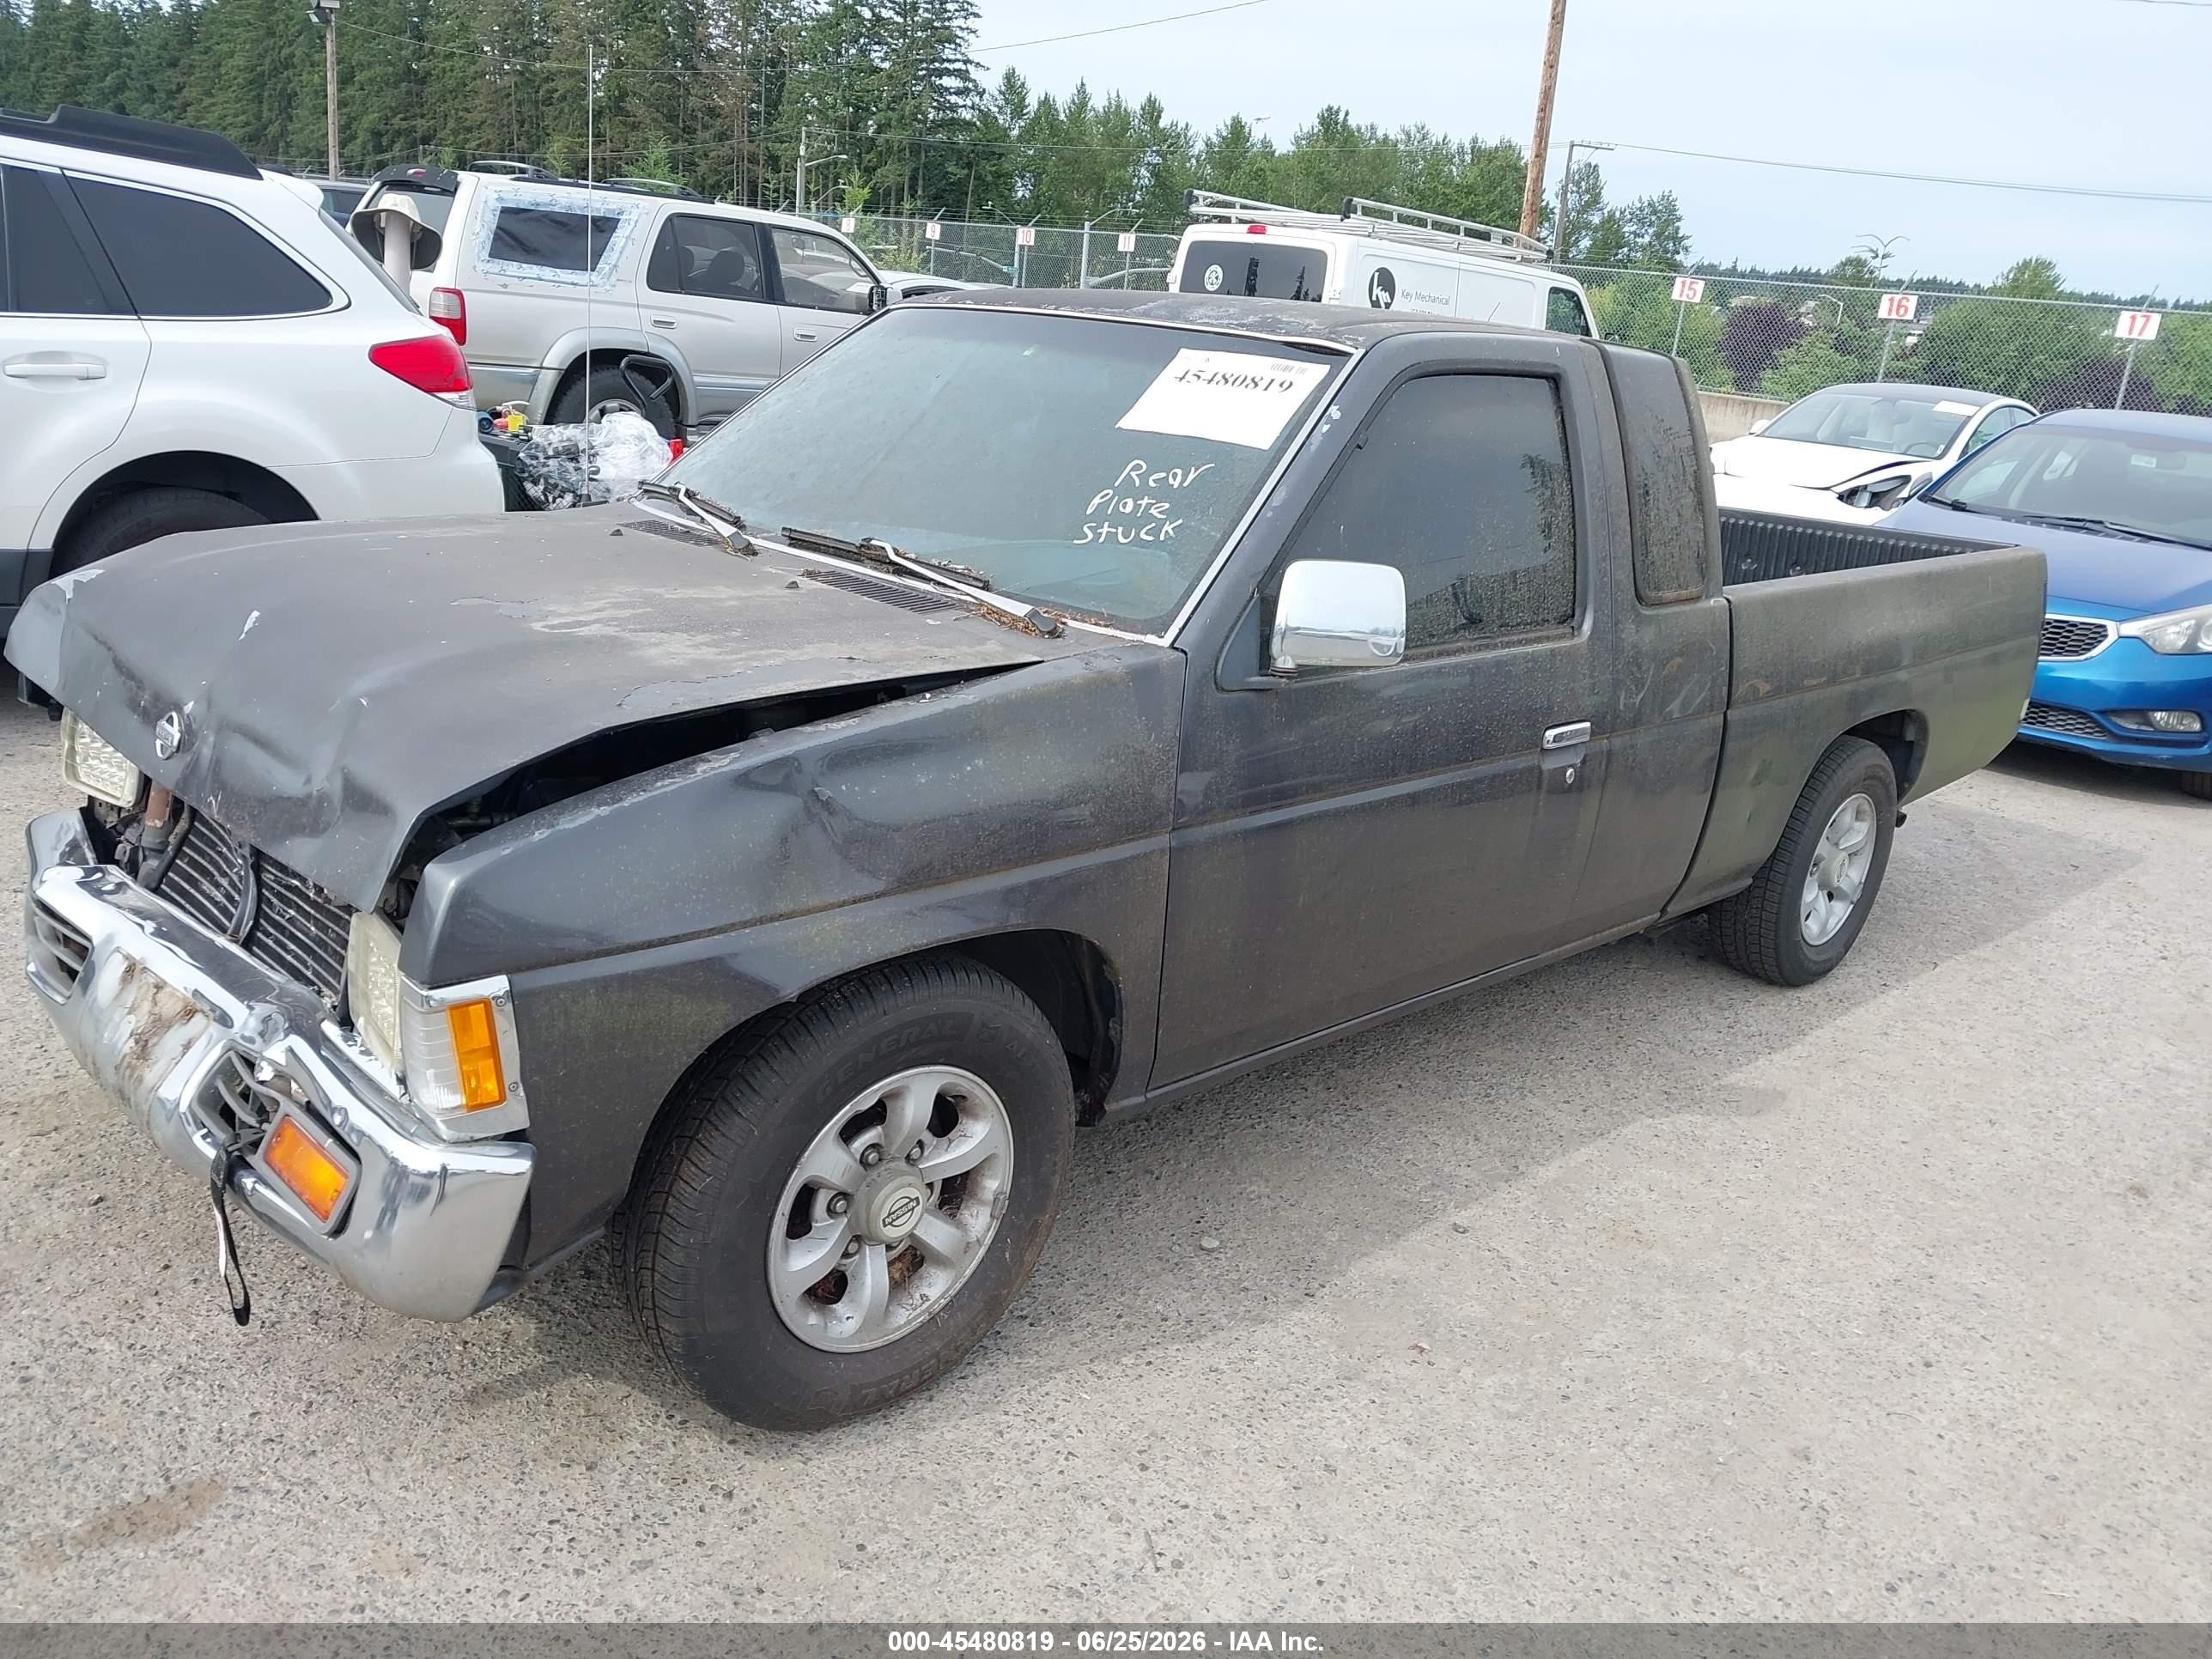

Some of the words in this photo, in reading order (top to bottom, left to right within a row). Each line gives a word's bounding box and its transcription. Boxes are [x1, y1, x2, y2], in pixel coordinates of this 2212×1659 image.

[930, 224, 936, 238] 9
[1021, 229, 1031, 244] 10
[1122, 235, 1131, 250] 11
[1401, 289, 1413, 303] Key
[1414, 290, 1450, 306] Mechanical
[1679, 279, 1699, 301] 15
[1887, 295, 1911, 318] 16
[2127, 313, 2152, 337] 17
[1174, 368, 1294, 393] 45480819
[1114, 459, 1216, 489] Rear
[1085, 489, 1170, 519] Plate
[884, 1198, 919, 1226] NISSAN
